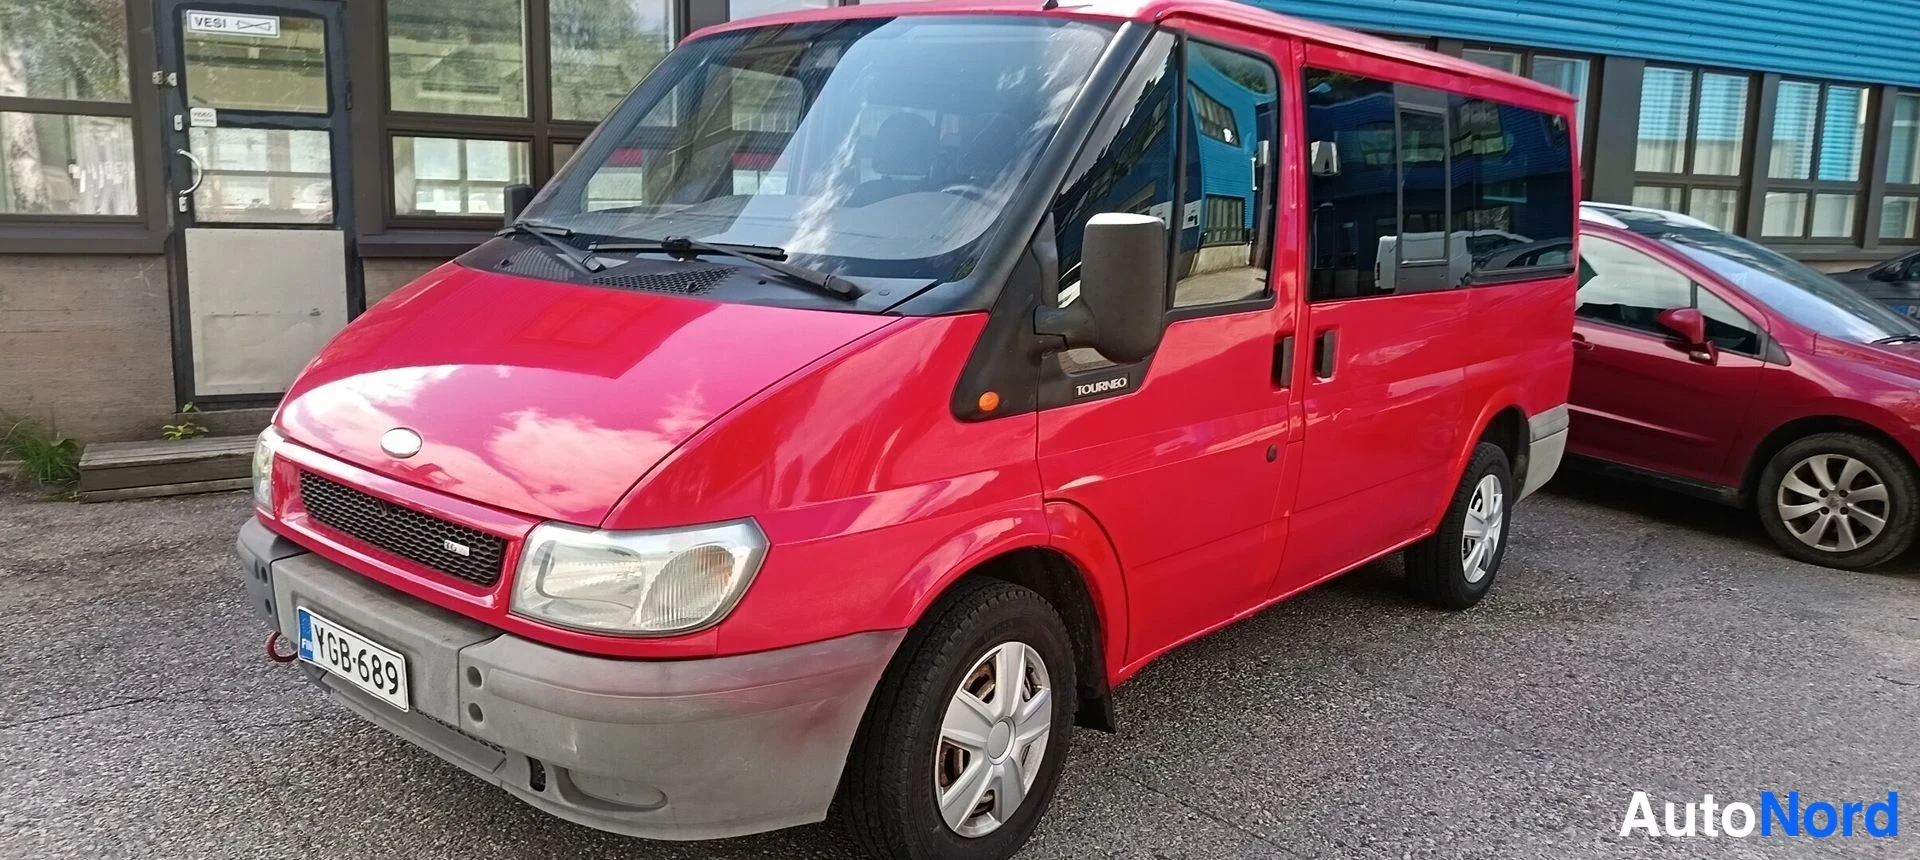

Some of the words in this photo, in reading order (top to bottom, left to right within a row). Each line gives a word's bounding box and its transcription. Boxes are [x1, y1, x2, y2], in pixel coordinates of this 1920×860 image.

[194, 16, 226, 28] VESI
[1076, 377, 1127, 396] TOURNEO
[314, 624, 399, 695] YGB-689
